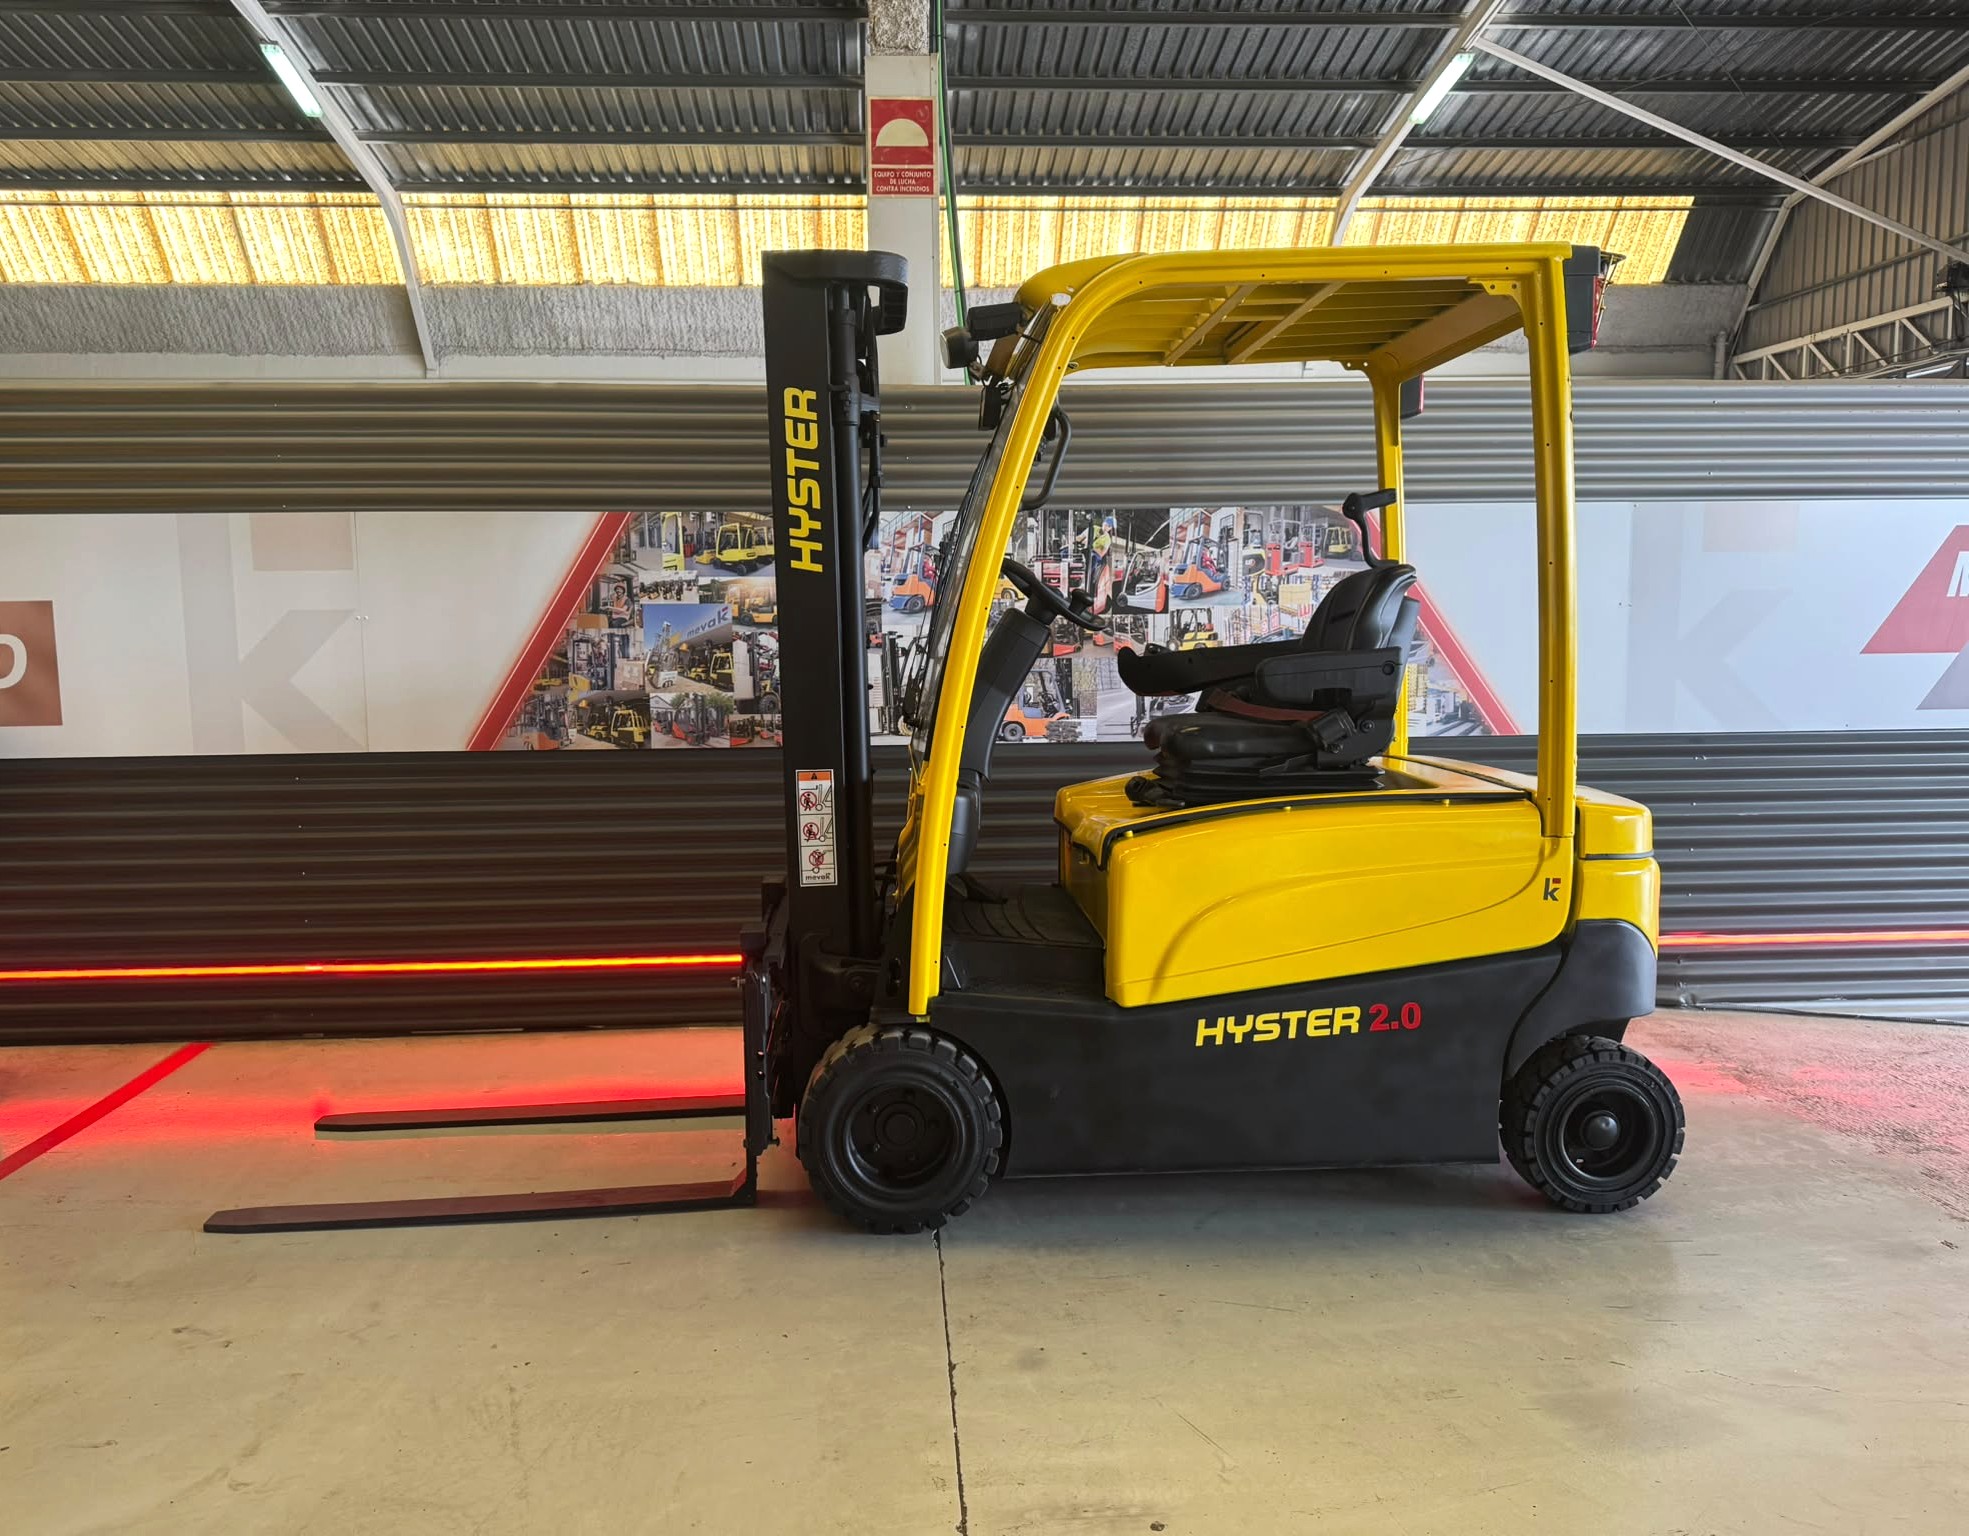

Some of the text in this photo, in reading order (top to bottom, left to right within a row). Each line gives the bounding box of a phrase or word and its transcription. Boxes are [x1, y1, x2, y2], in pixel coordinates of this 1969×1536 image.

[783, 387, 823, 573] HYSTER
[1195, 1002, 1422, 1047] HYSTER 2.0
